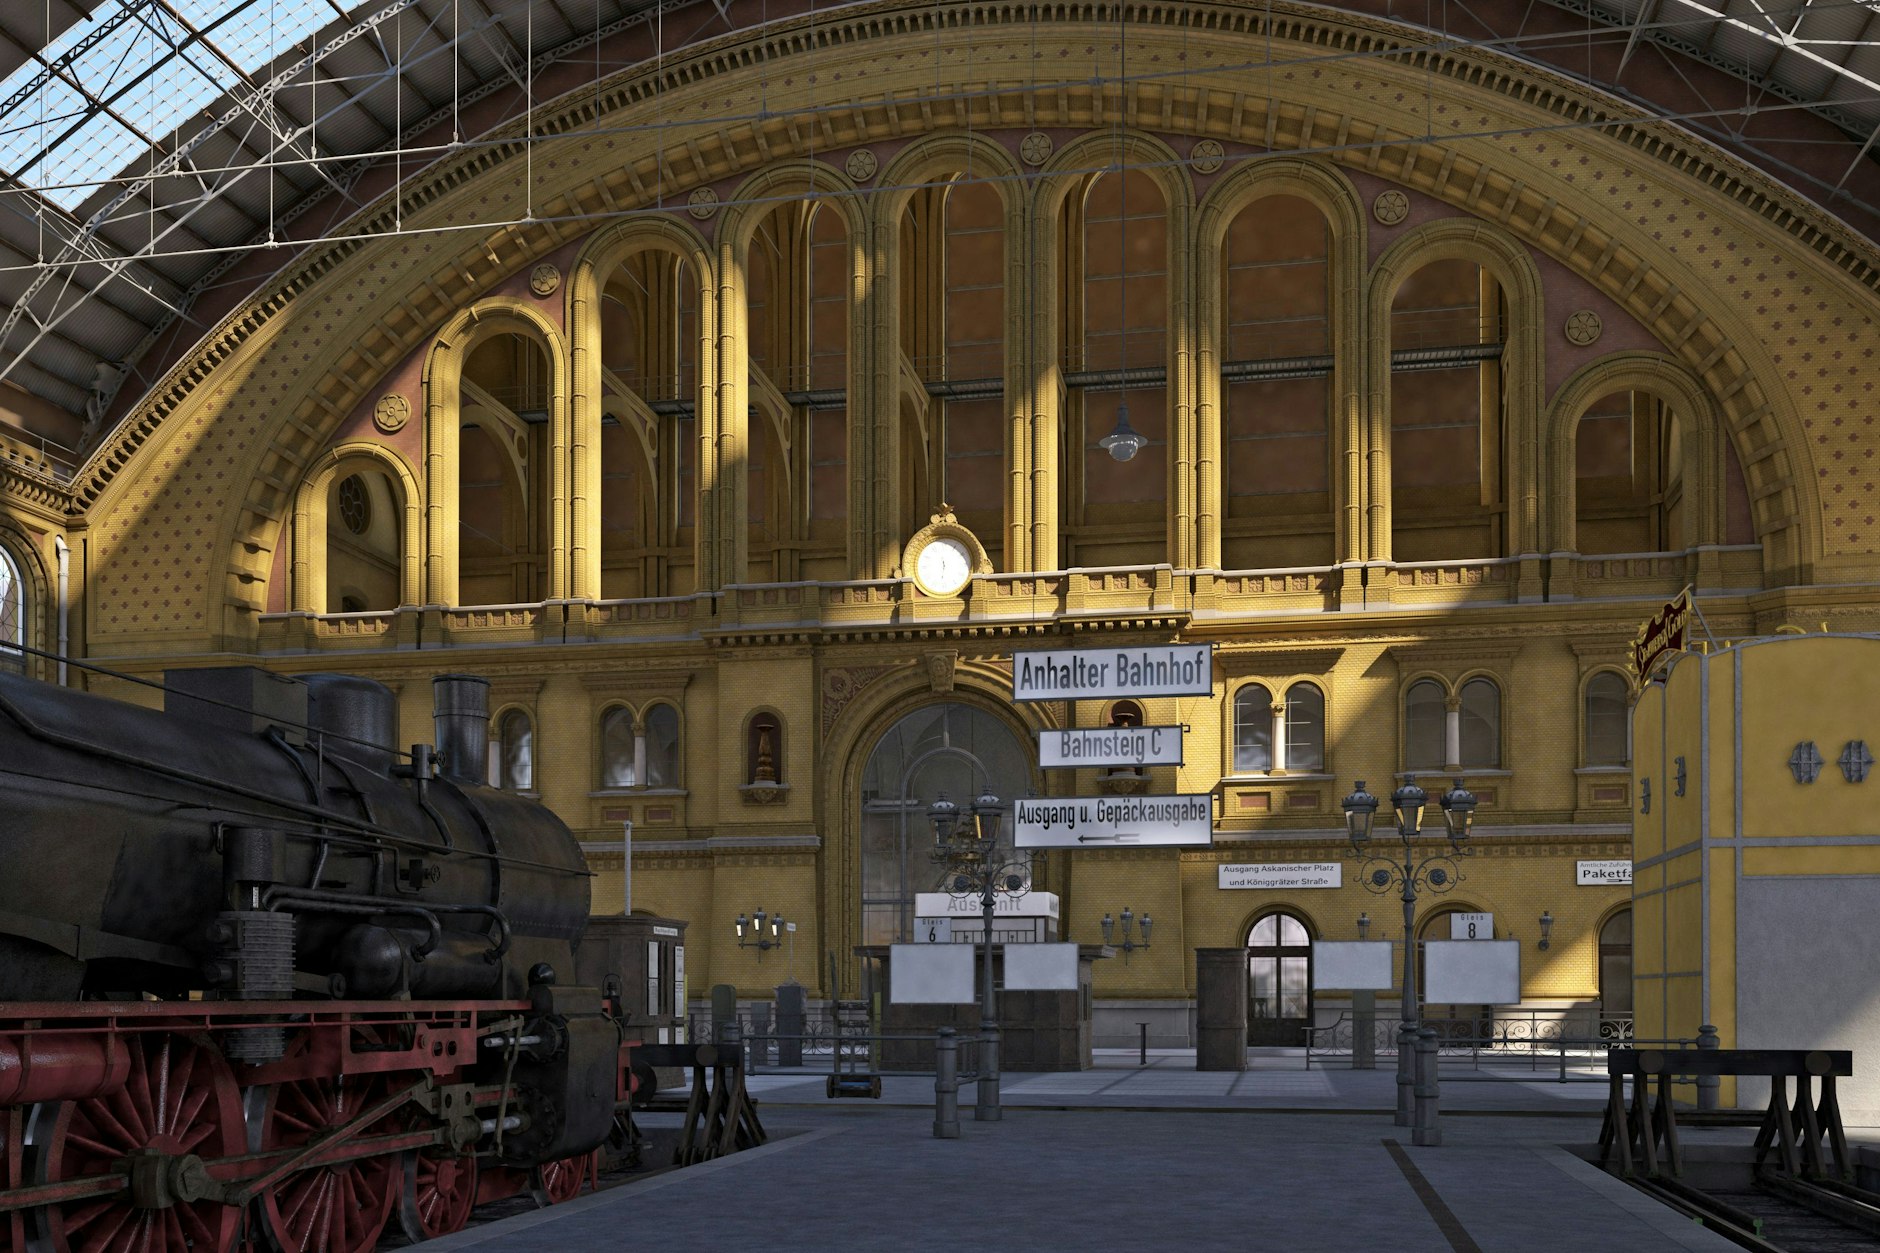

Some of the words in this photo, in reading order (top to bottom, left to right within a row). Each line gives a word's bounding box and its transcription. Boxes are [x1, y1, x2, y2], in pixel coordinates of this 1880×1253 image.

[1020, 656, 1109, 691] Anhalter
[1116, 651, 1203, 687] Bahnhof
[1061, 730, 1145, 763] Bahnsteig
[1151, 728, 1162, 756] C
[1018, 801, 1075, 829] Ausgang
[1080, 806, 1092, 824] u.
[1097, 797, 1206, 829] Gepäckausgabe
[1247, 878, 1299, 887] Königgrätzer
[947, 896, 1021, 911] Ausnft
[928, 927, 936, 942] 6
[1468, 922, 1476, 939] 8
